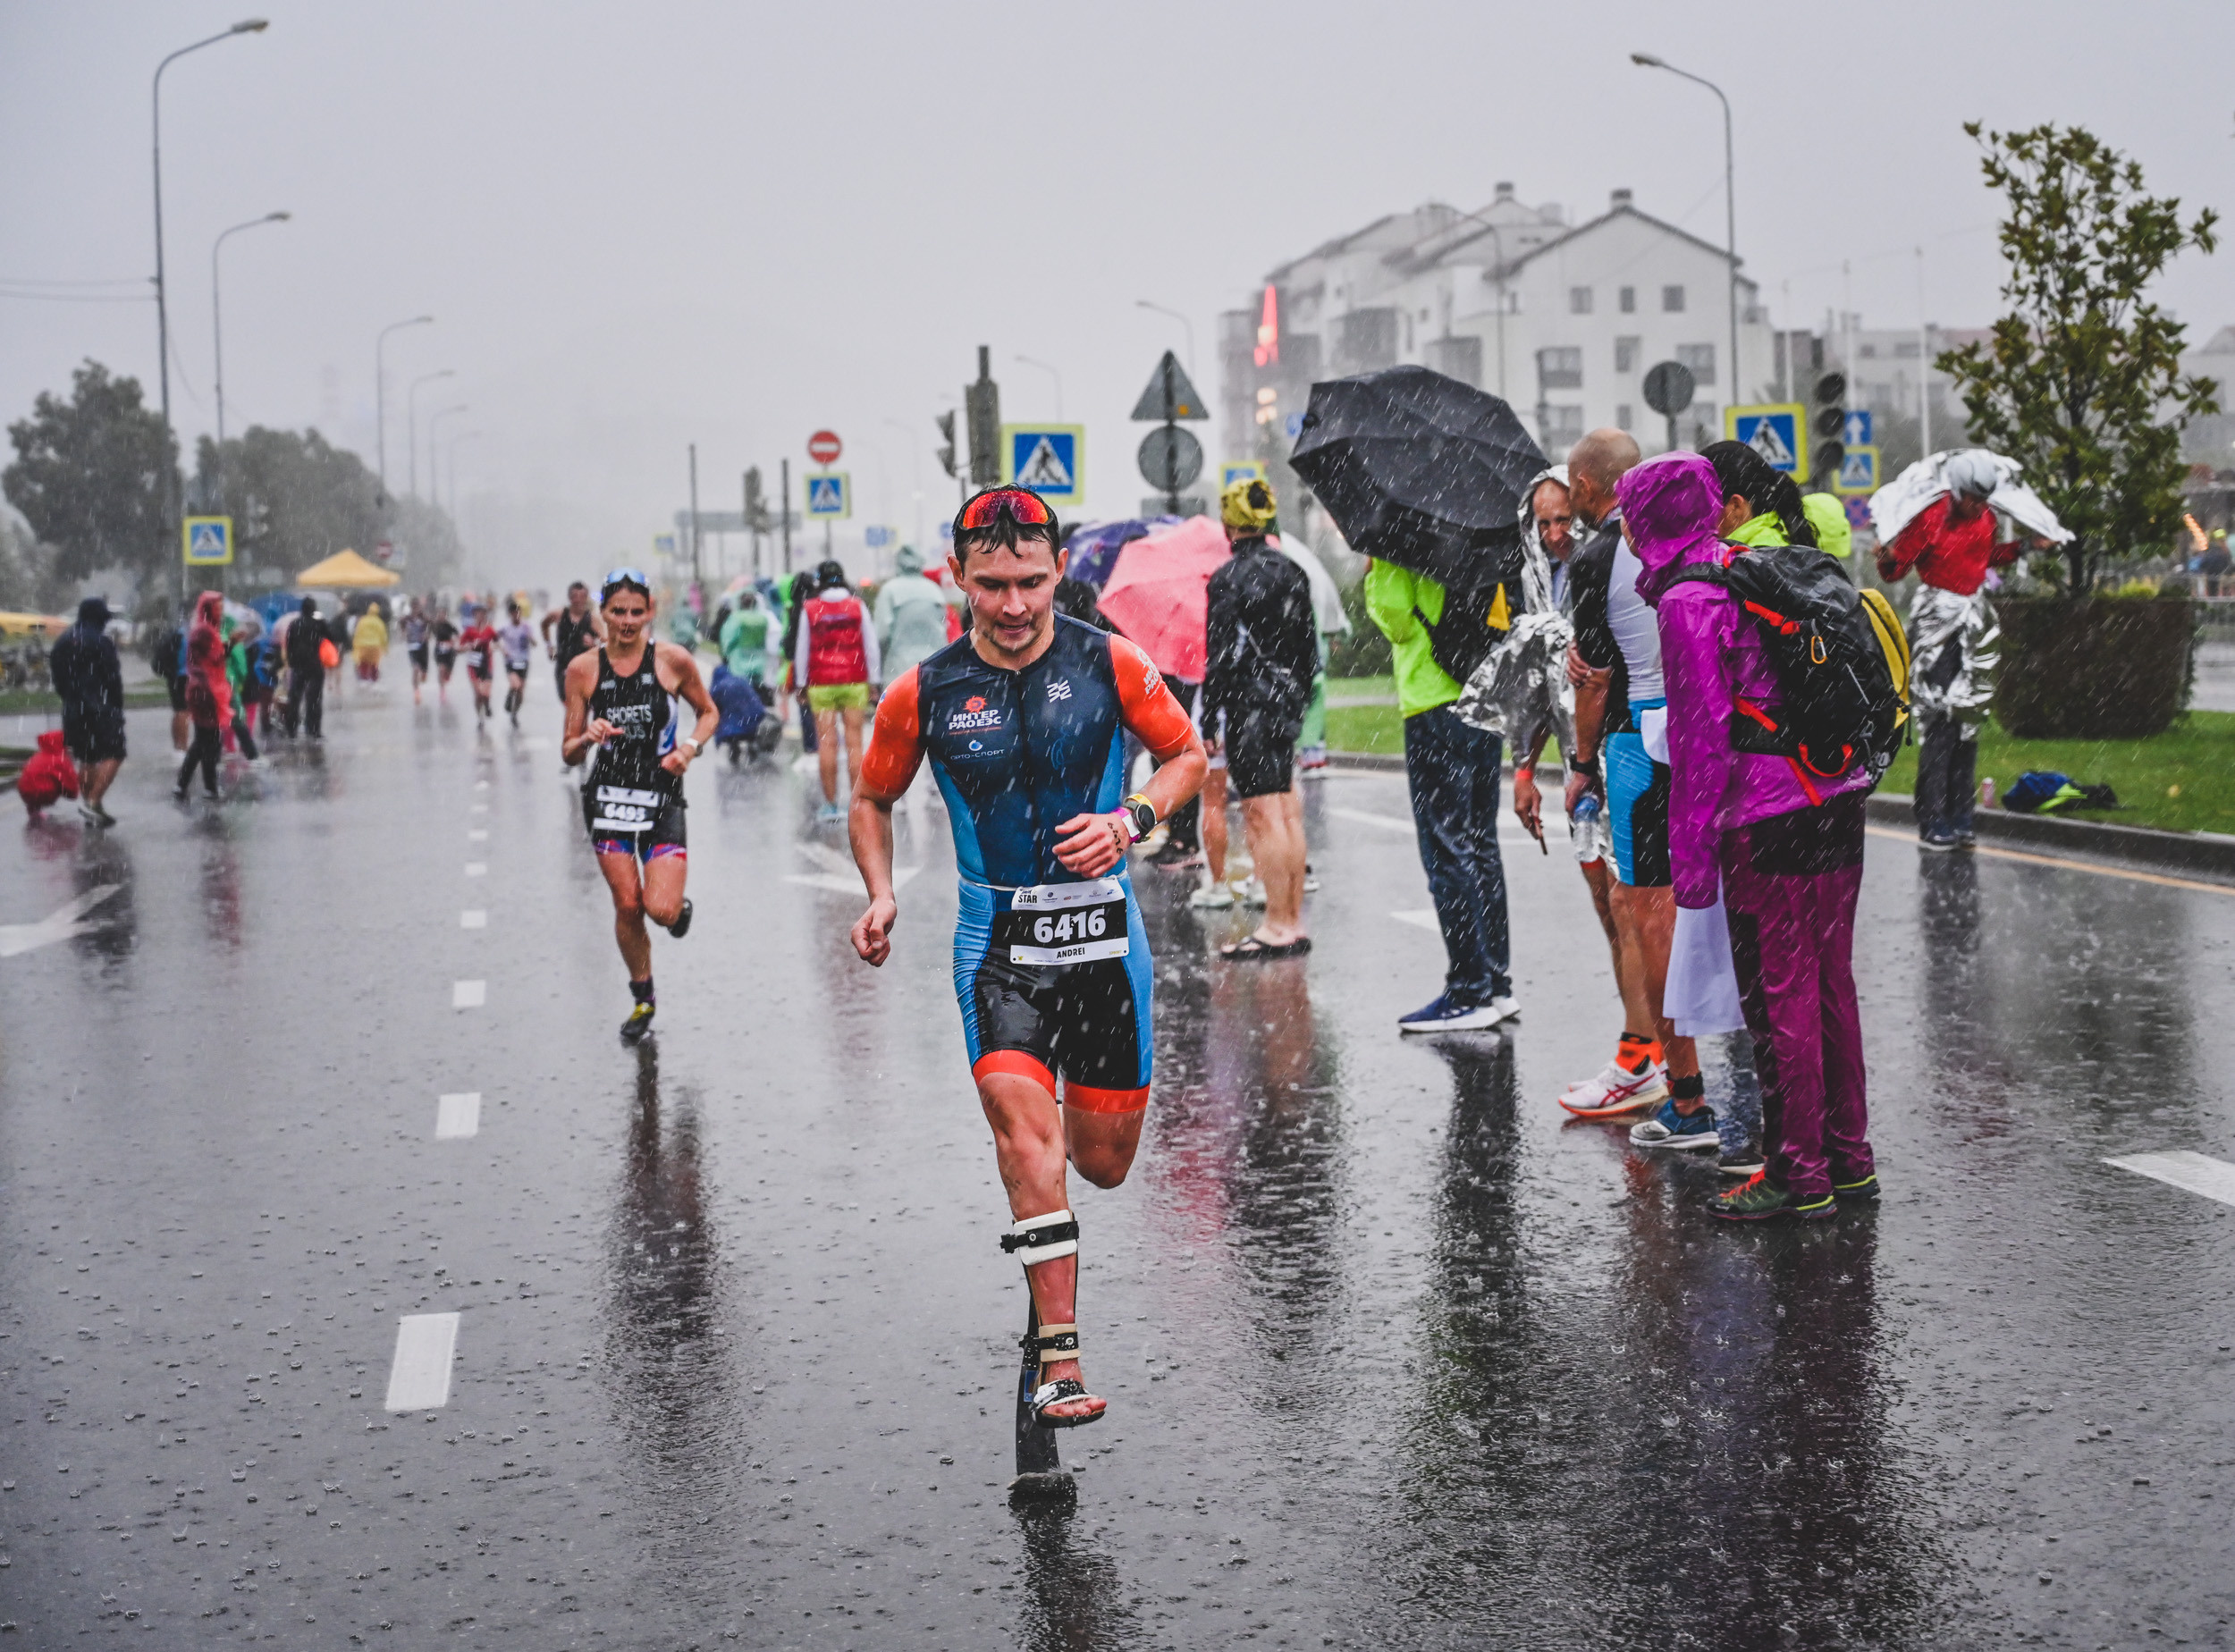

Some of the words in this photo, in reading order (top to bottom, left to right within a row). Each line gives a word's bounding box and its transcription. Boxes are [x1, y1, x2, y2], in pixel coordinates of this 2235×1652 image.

[607, 704, 652, 725] SHORETS
[952, 710, 999, 722] ИНТЕР
[949, 720, 975, 729] РАО
[976, 716, 1002, 727] ЕЭС
[950, 749, 1005, 760] ОРТО-СПОРТ
[1018, 894, 1037, 904] STAR
[1033, 908, 1106, 943] 6416
[1056, 947, 1085, 959] ANDREI
